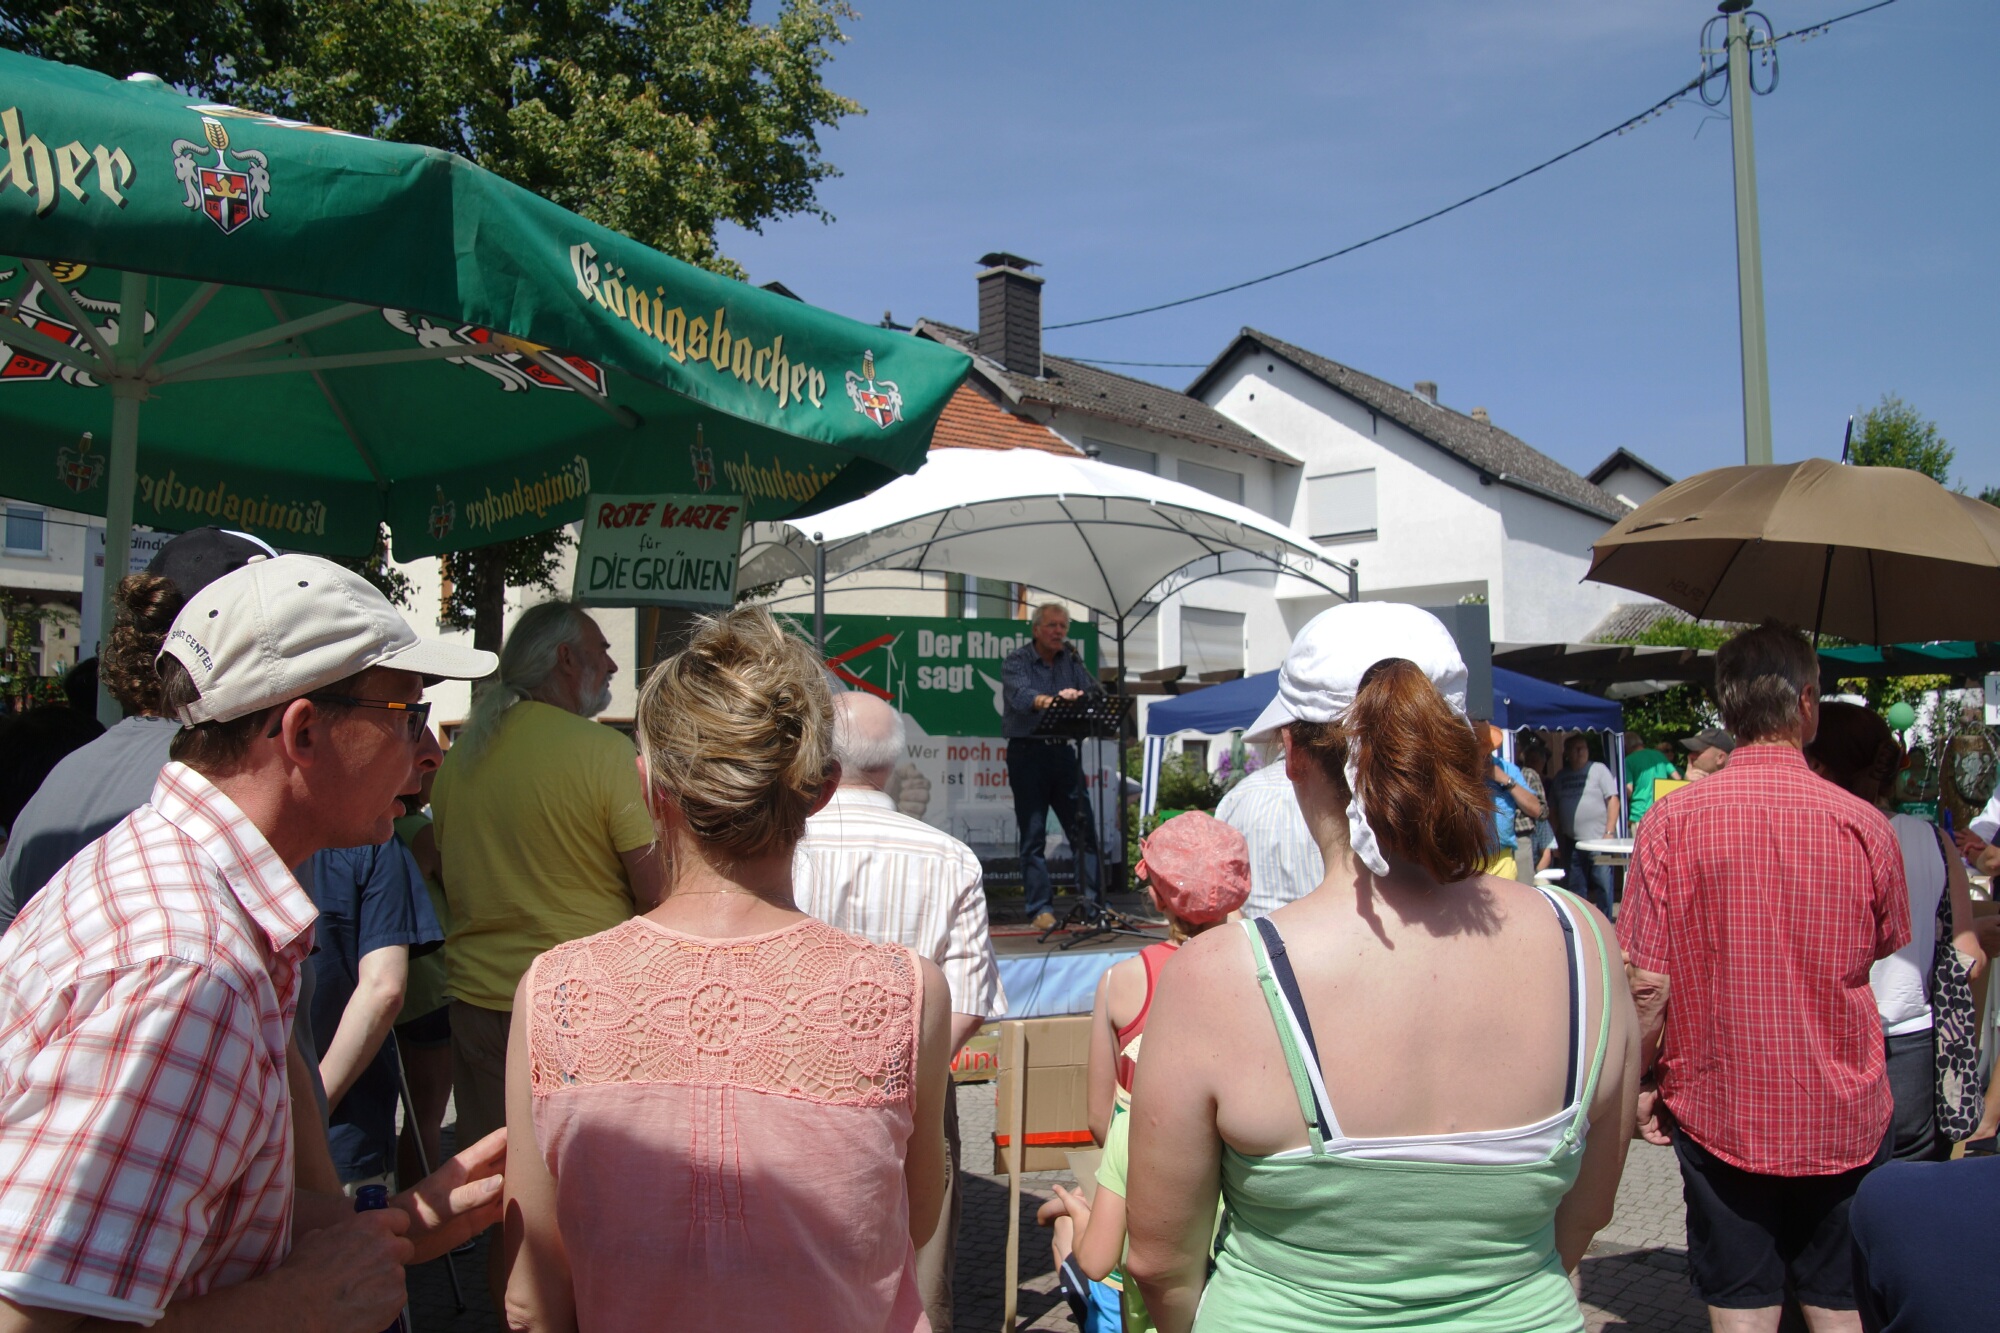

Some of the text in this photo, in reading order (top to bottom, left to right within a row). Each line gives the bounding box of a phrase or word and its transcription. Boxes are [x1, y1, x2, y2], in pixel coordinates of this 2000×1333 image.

[569, 241, 827, 410] Königsbacher
[597, 502, 739, 531] ROTE KARTE
[638, 533, 662, 552] für
[185, 634, 214, 673] CENTER
[917, 629, 962, 659] Der
[917, 664, 974, 693] sagt
[907, 745, 939, 759] Wer
[947, 742, 990, 761] noch
[941, 771, 964, 785] ist
